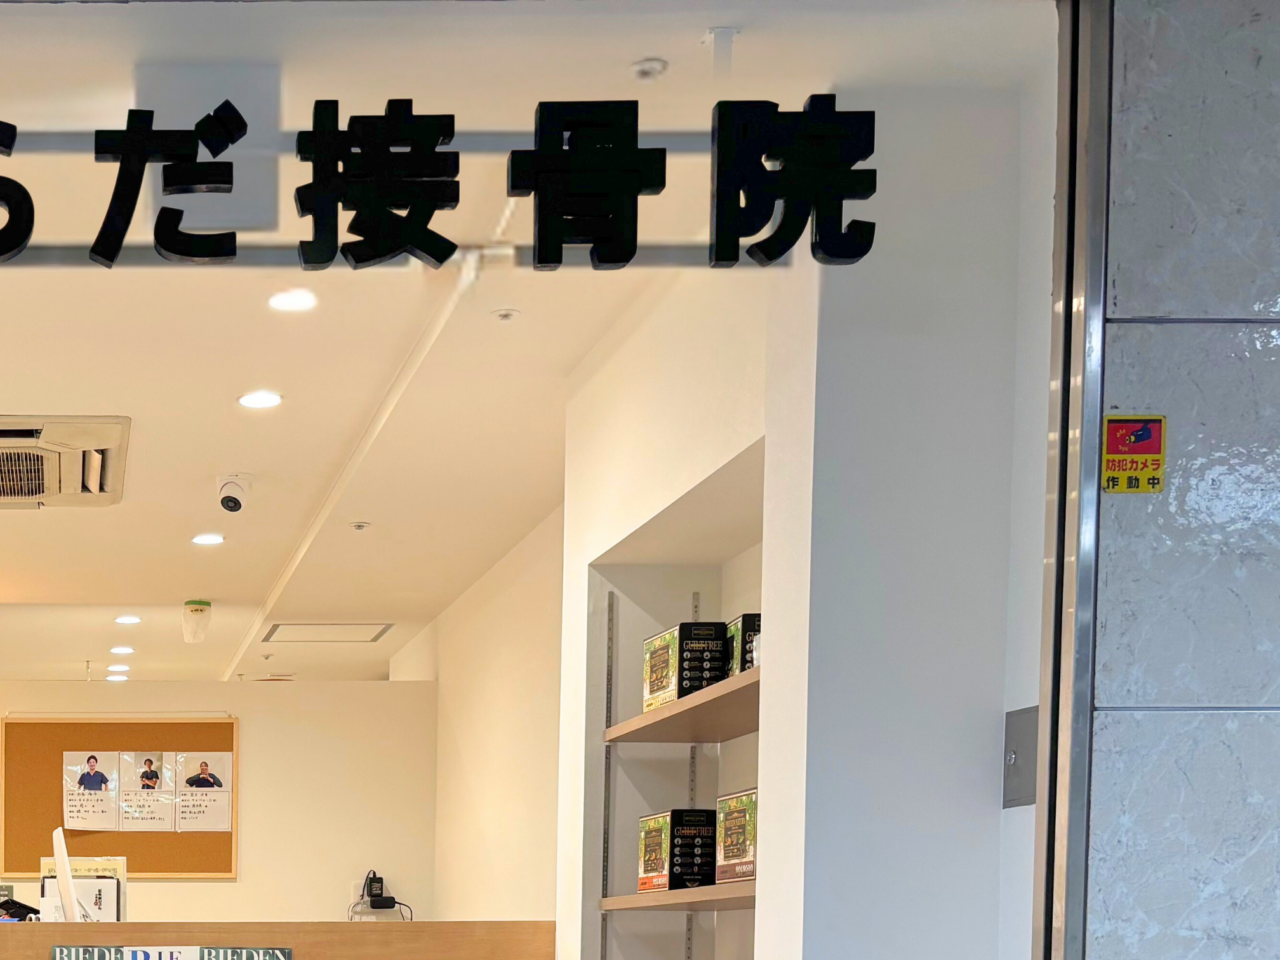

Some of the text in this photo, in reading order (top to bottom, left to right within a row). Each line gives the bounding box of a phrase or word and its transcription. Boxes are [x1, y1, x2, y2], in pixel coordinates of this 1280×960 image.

[1105, 458, 1161, 472] 防犯カメラ
[1106, 476, 1160, 489] 作動中
